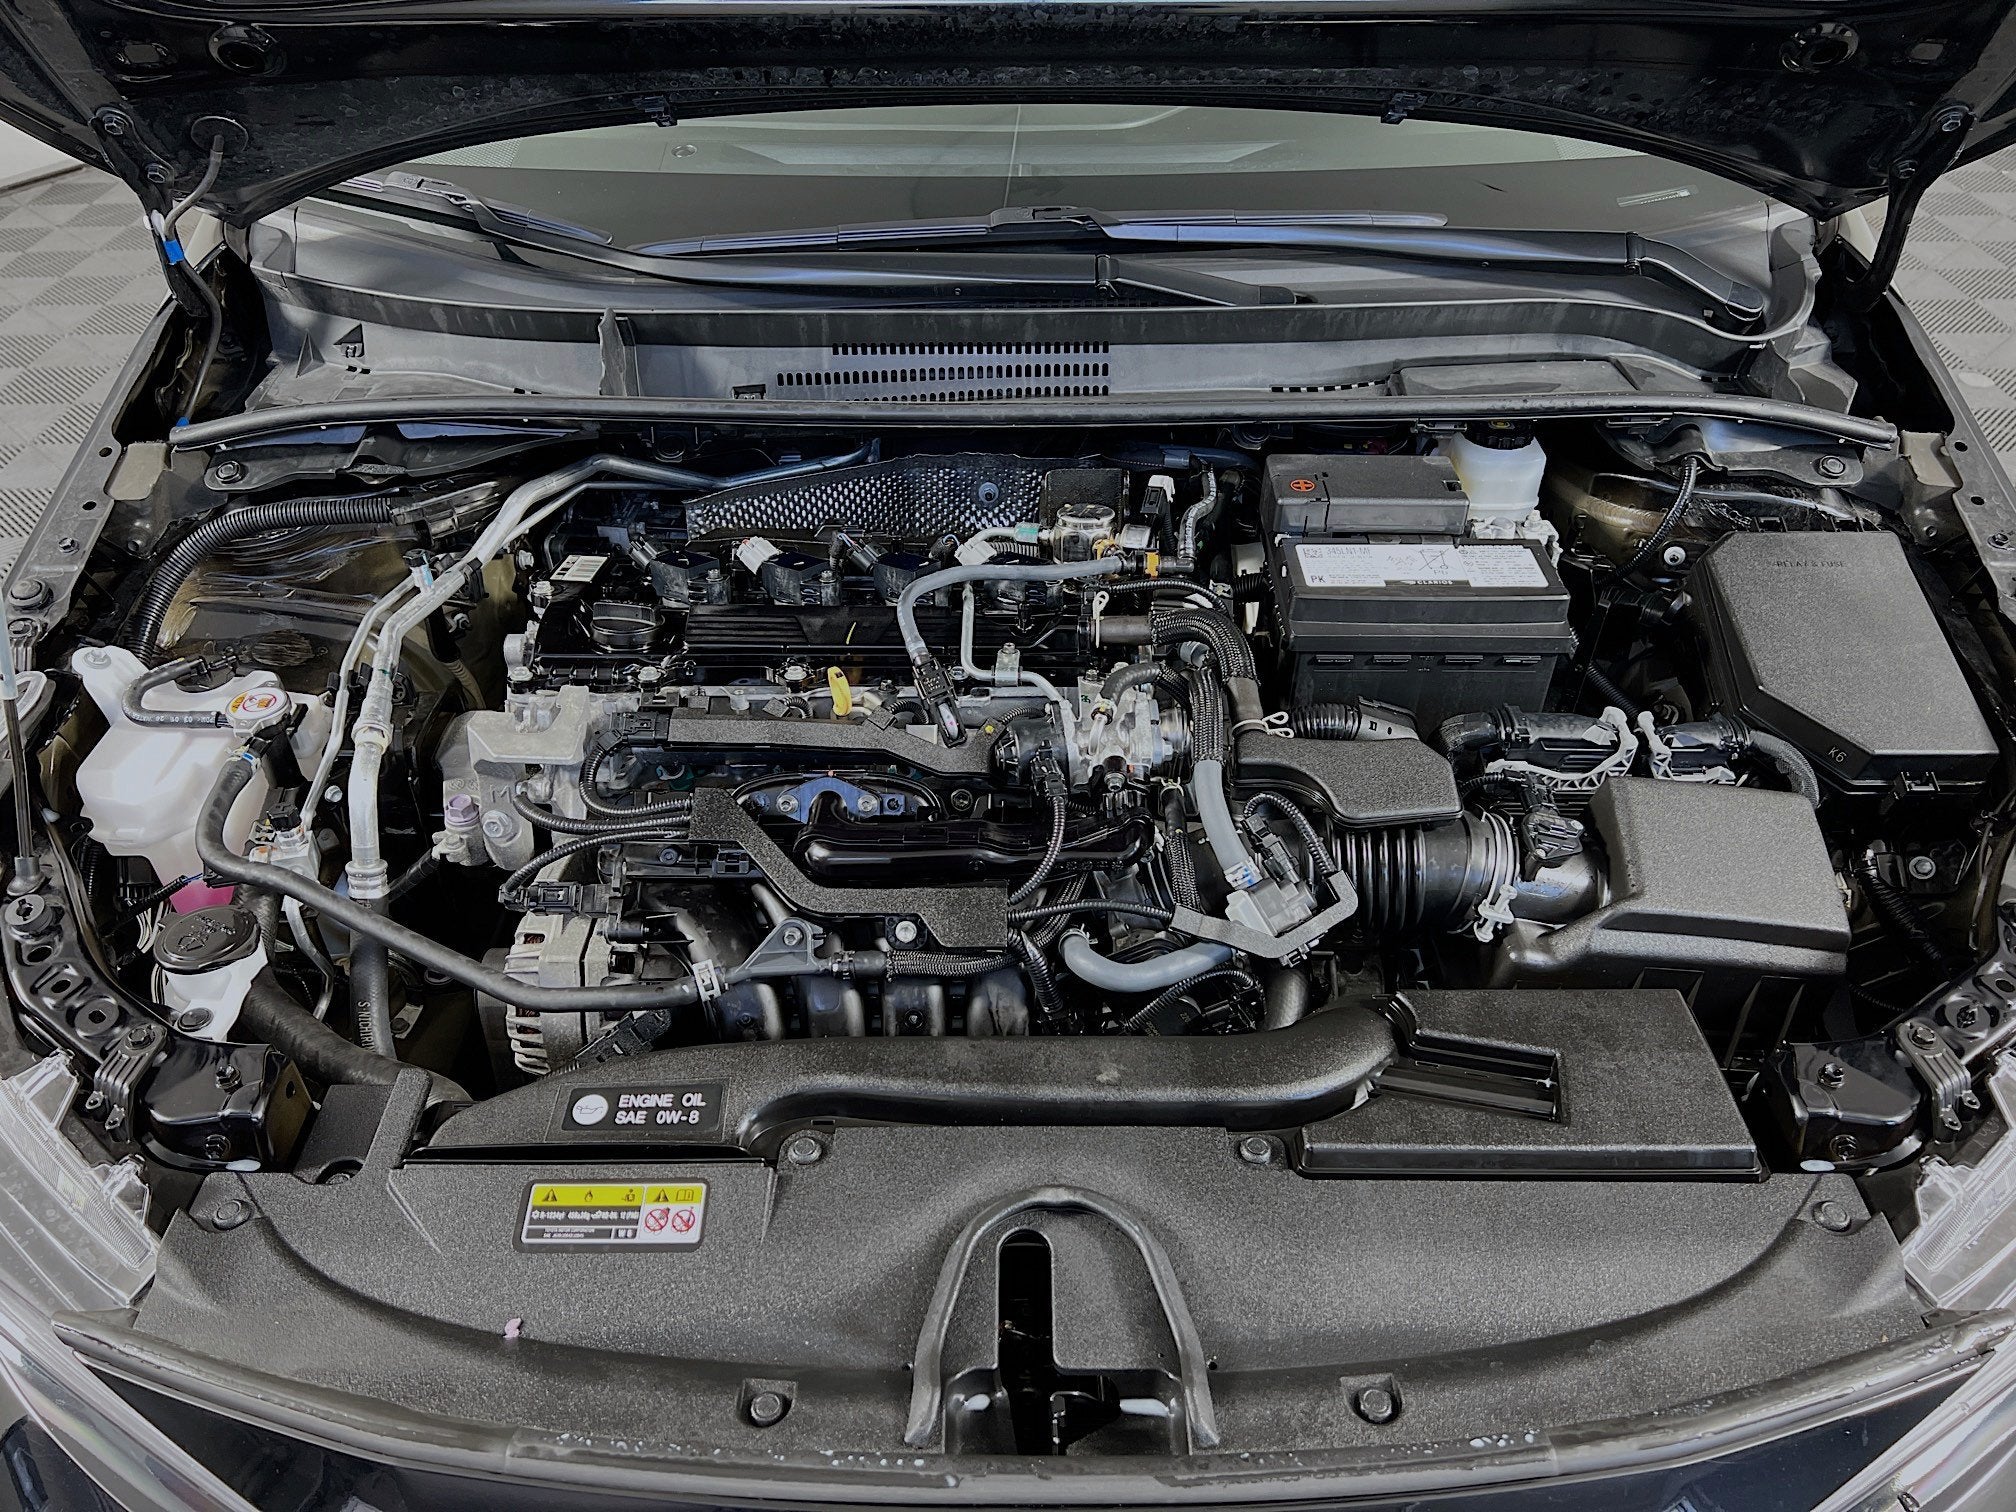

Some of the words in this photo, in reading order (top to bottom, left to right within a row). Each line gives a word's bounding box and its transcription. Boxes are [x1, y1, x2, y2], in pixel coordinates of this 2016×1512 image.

[1310, 575, 1327, 584] PK
[1826, 746, 1848, 763] K6
[617, 1092, 675, 1109] ENGINE
[681, 1092, 708, 1108] OIL
[614, 1110, 648, 1125] SAE
[655, 1110, 701, 1125] 0W-8
